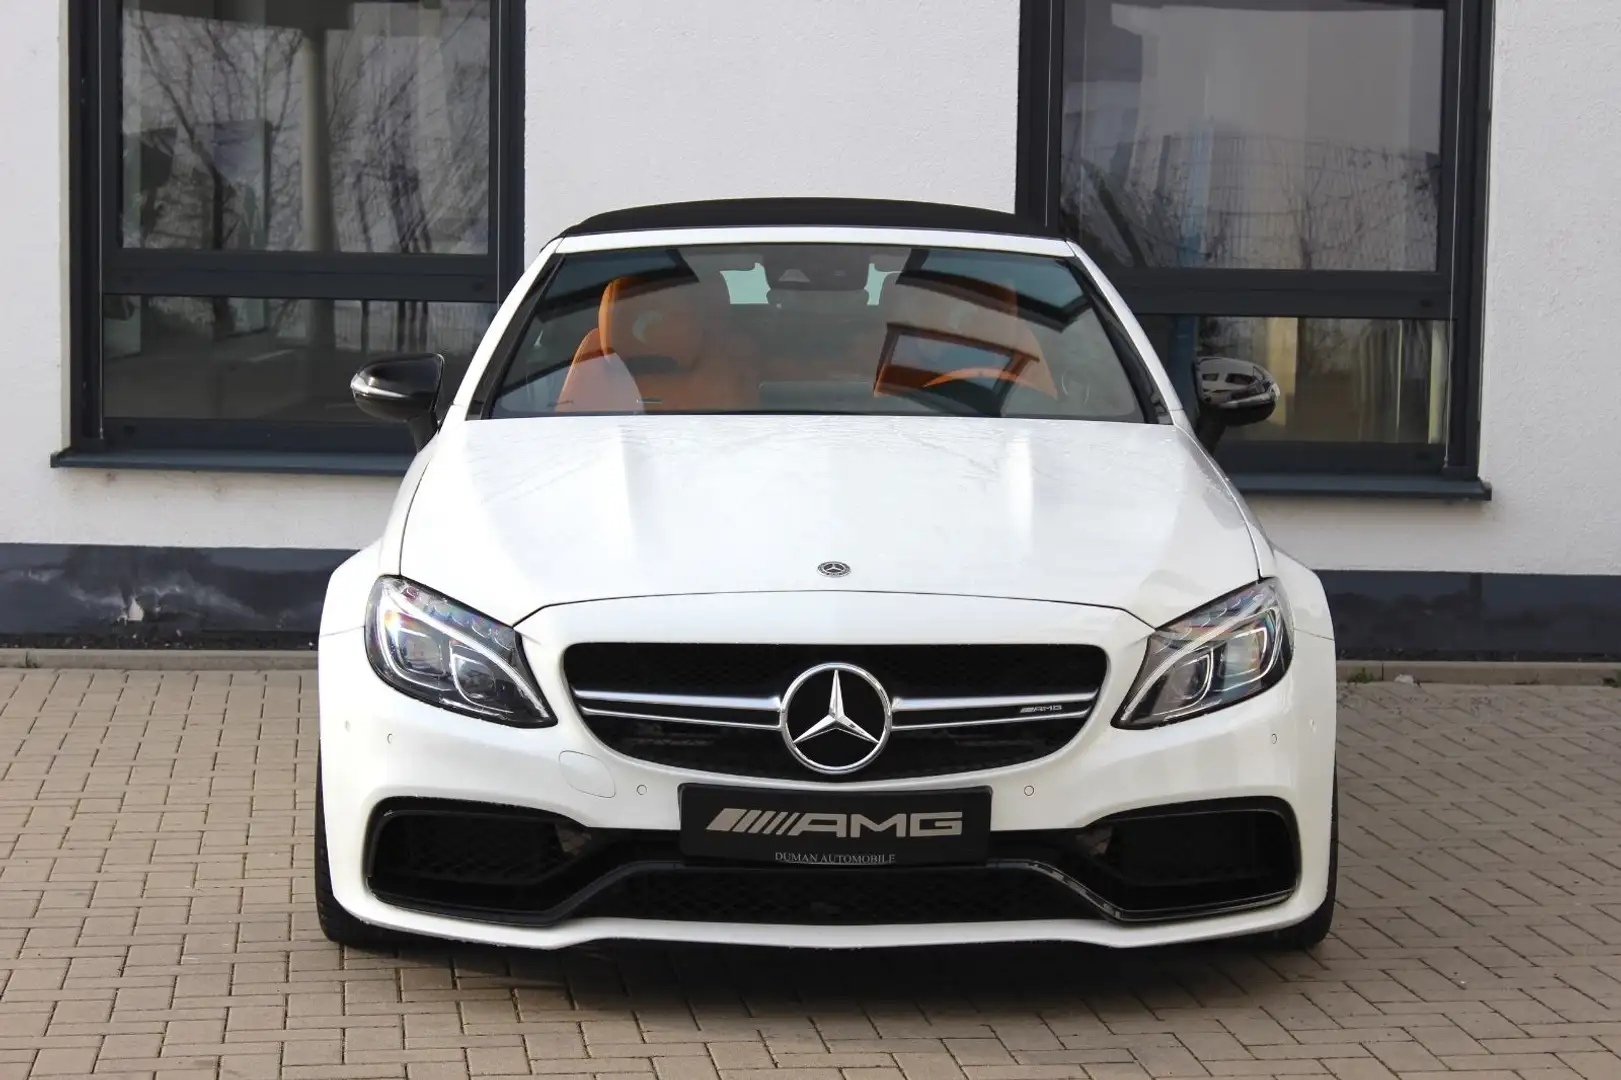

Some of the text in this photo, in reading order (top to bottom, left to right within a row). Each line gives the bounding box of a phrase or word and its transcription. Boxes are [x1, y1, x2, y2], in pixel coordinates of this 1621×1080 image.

[787, 811, 963, 838] AMG
[775, 851, 896, 865] DUMAN AUTOMOBILE
